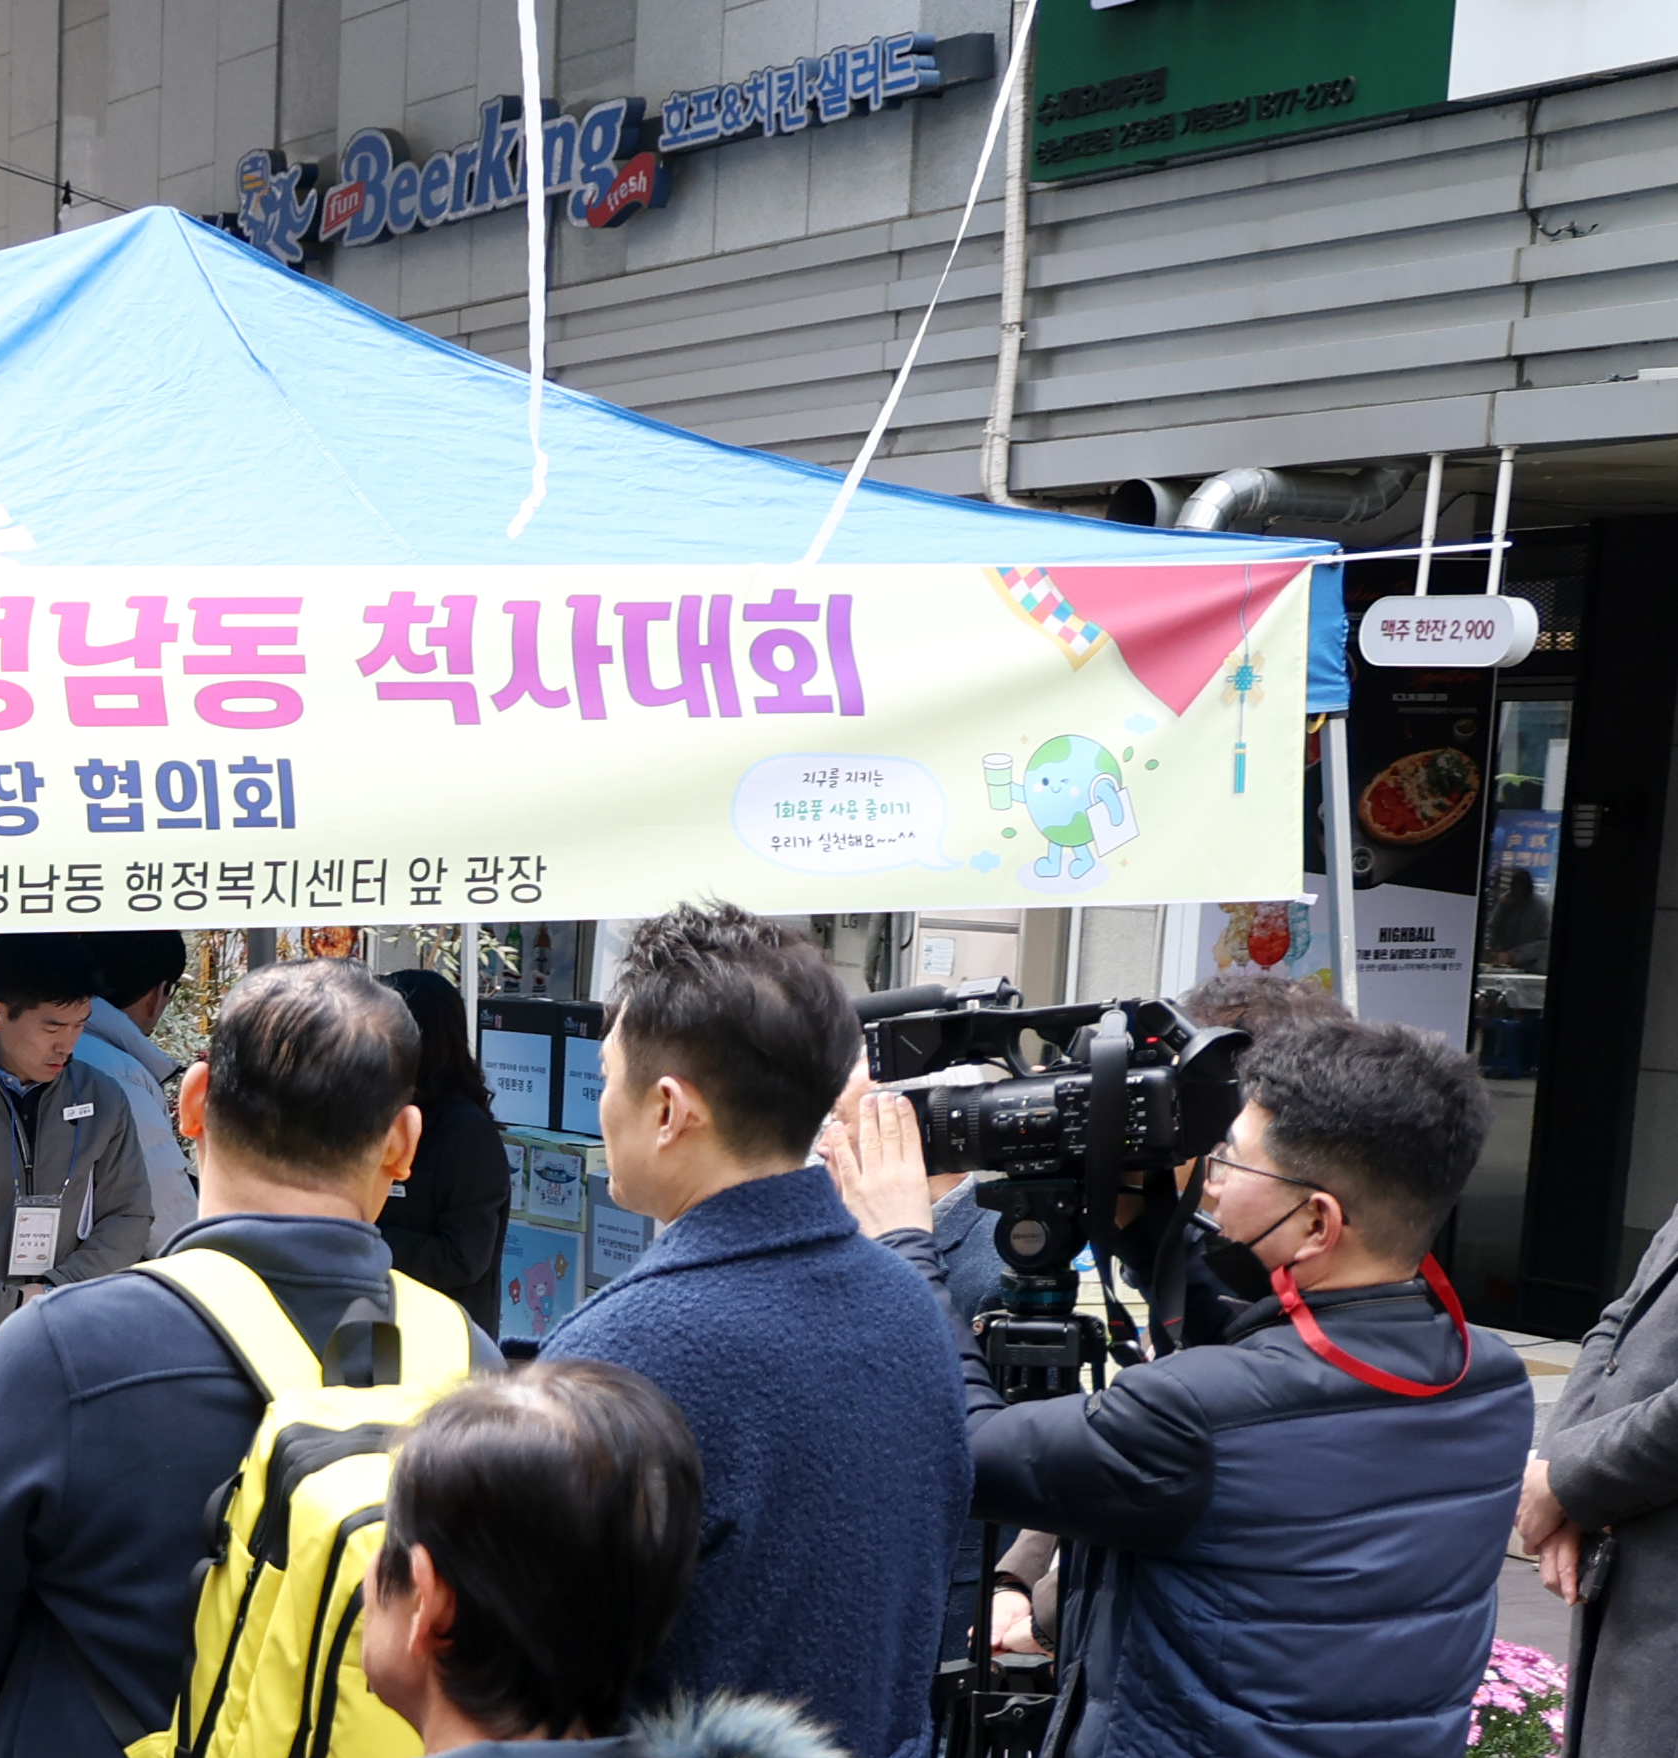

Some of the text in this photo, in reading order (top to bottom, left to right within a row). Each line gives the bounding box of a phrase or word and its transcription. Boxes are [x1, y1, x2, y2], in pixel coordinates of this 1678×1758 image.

[341, 95, 630, 248] Beerkng
[328, 189, 362, 221] fun
[605, 171, 648, 213] fresh
[1381, 618, 1495, 643] 맥주 한잔 2,900
[356, 589, 865, 725] 척사대회
[802, 768, 885, 788] 지구를 지키는
[74, 755, 297, 834] 협의회
[829, 800, 859, 820] 사용
[865, 799, 912, 821] 줄이기
[771, 835, 813, 852] 우리가
[125, 856, 388, 911] 행정복지센터
[408, 857, 448, 906] 앞
[464, 855, 547, 905] 광장
[842, 914, 858, 929] LG
[1379, 927, 1436, 943] HIGHBALL
